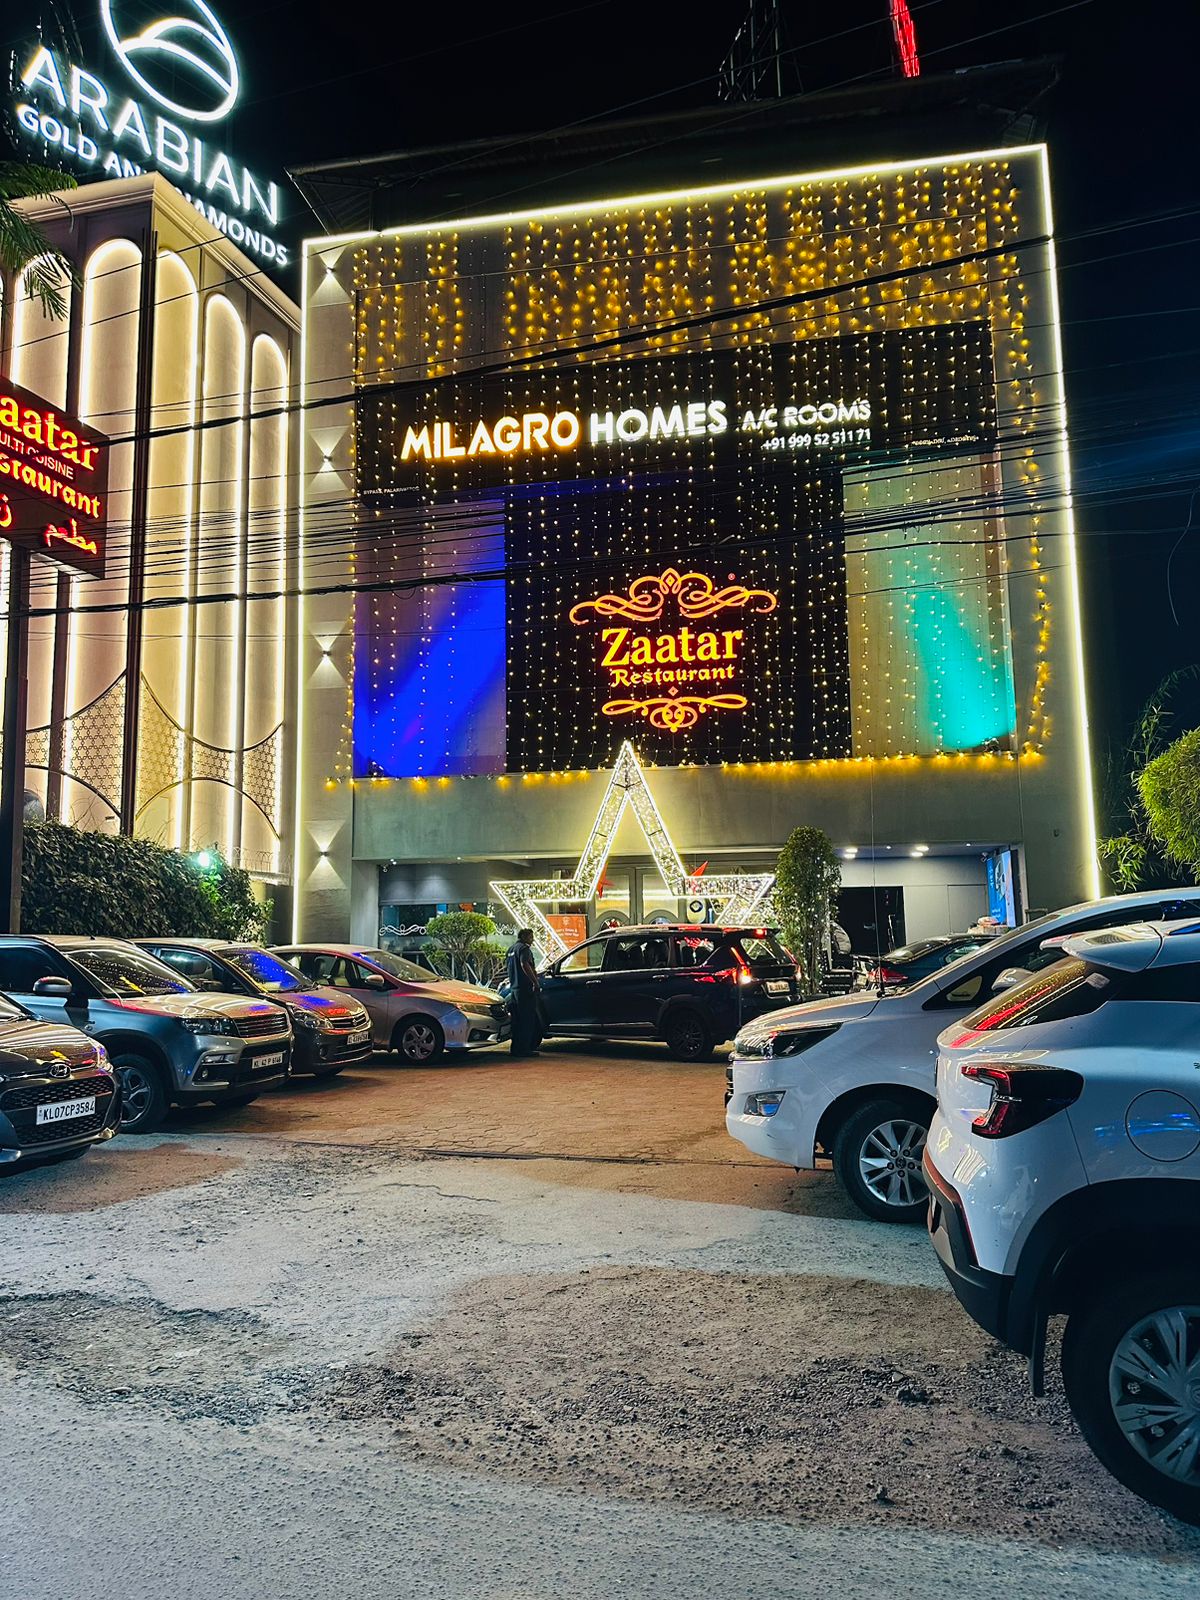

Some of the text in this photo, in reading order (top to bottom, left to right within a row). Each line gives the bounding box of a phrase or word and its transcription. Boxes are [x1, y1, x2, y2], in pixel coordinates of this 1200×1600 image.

[21, 46, 279, 226] ARABIAN
[17, 103, 289, 267] GOLD AN AMONDS
[401, 400, 728, 460] MILAGRO HOMES
[741, 400, 871, 430] A/C ROOMS
[762, 427, 871, 450] +91 999 52 511 71
[601, 627, 743, 666] Zaatar
[611, 664, 735, 688] Restaurant
[43, 1101, 95, 1120] KL07CP3584
